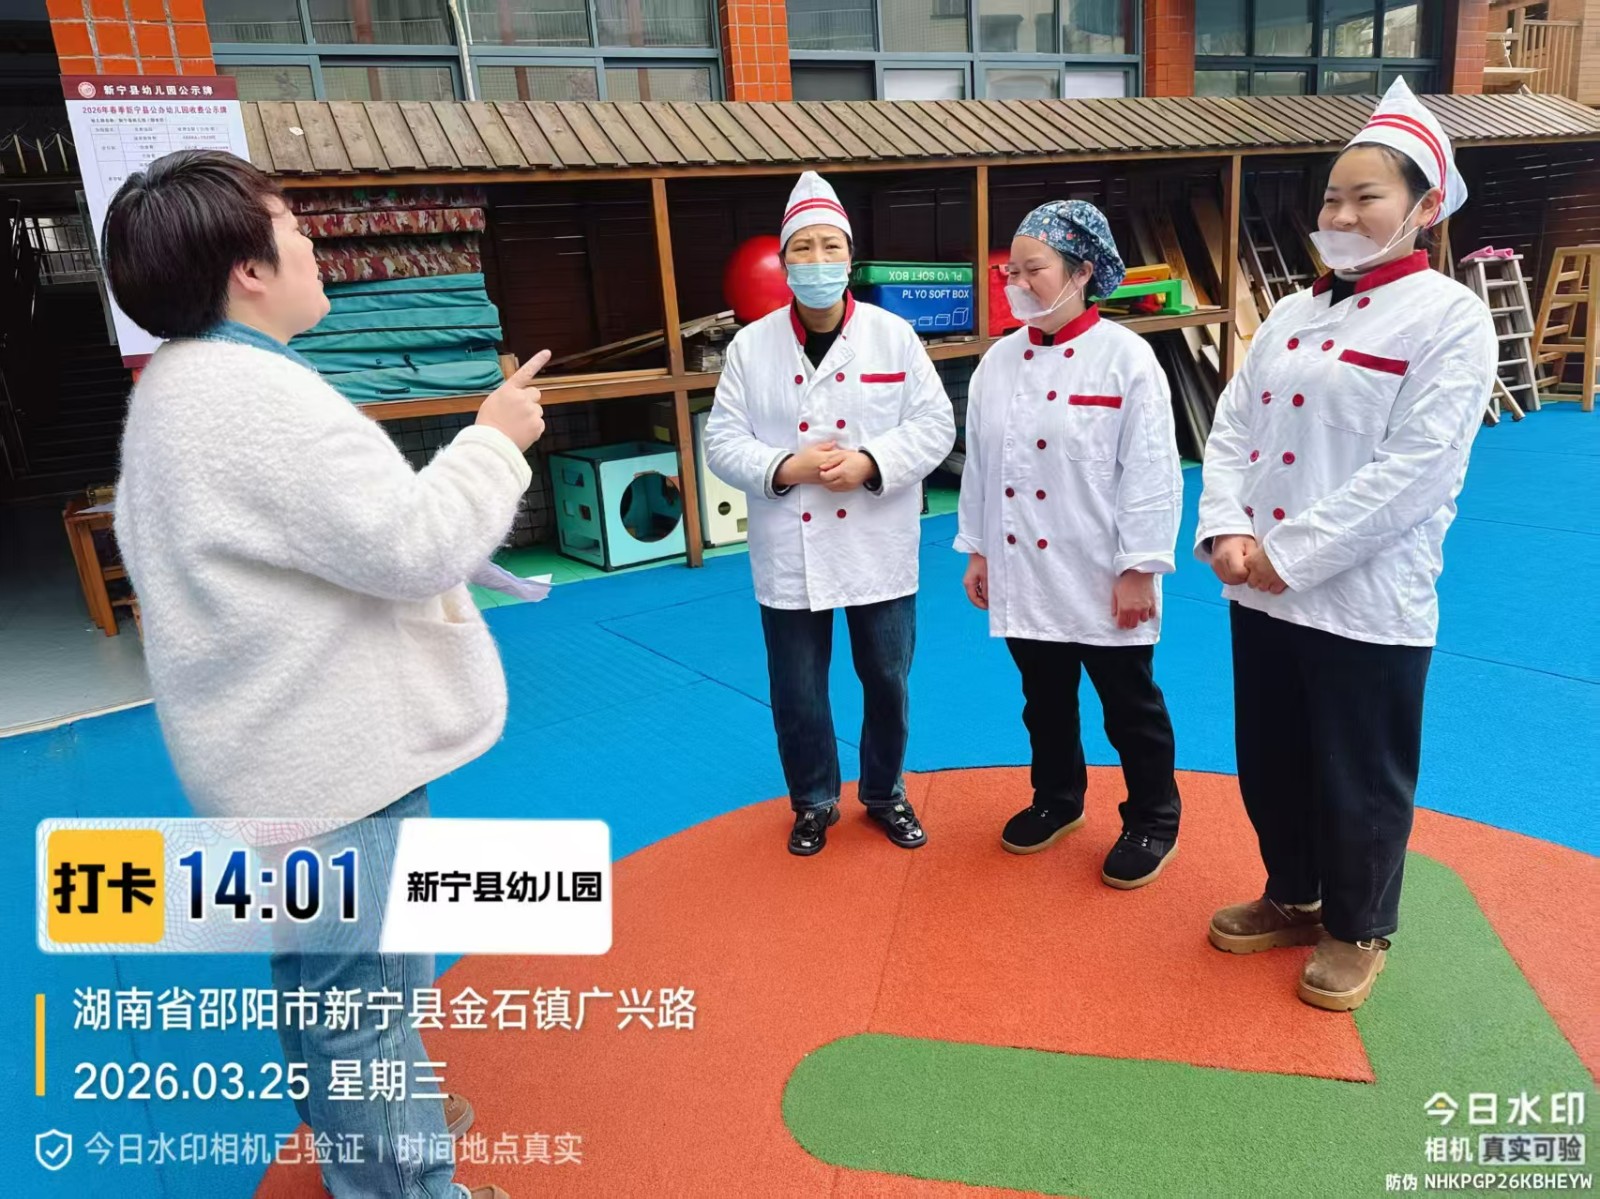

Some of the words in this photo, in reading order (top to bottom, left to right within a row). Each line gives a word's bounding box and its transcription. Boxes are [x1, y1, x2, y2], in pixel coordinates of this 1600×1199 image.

[103, 85, 213, 96] 新宁县幼儿园公示牌
[889, 271, 910, 281] BOX
[911, 271, 935, 281] SOFT
[928, 289, 951, 299] SOFT
[952, 289, 969, 299] BOX
